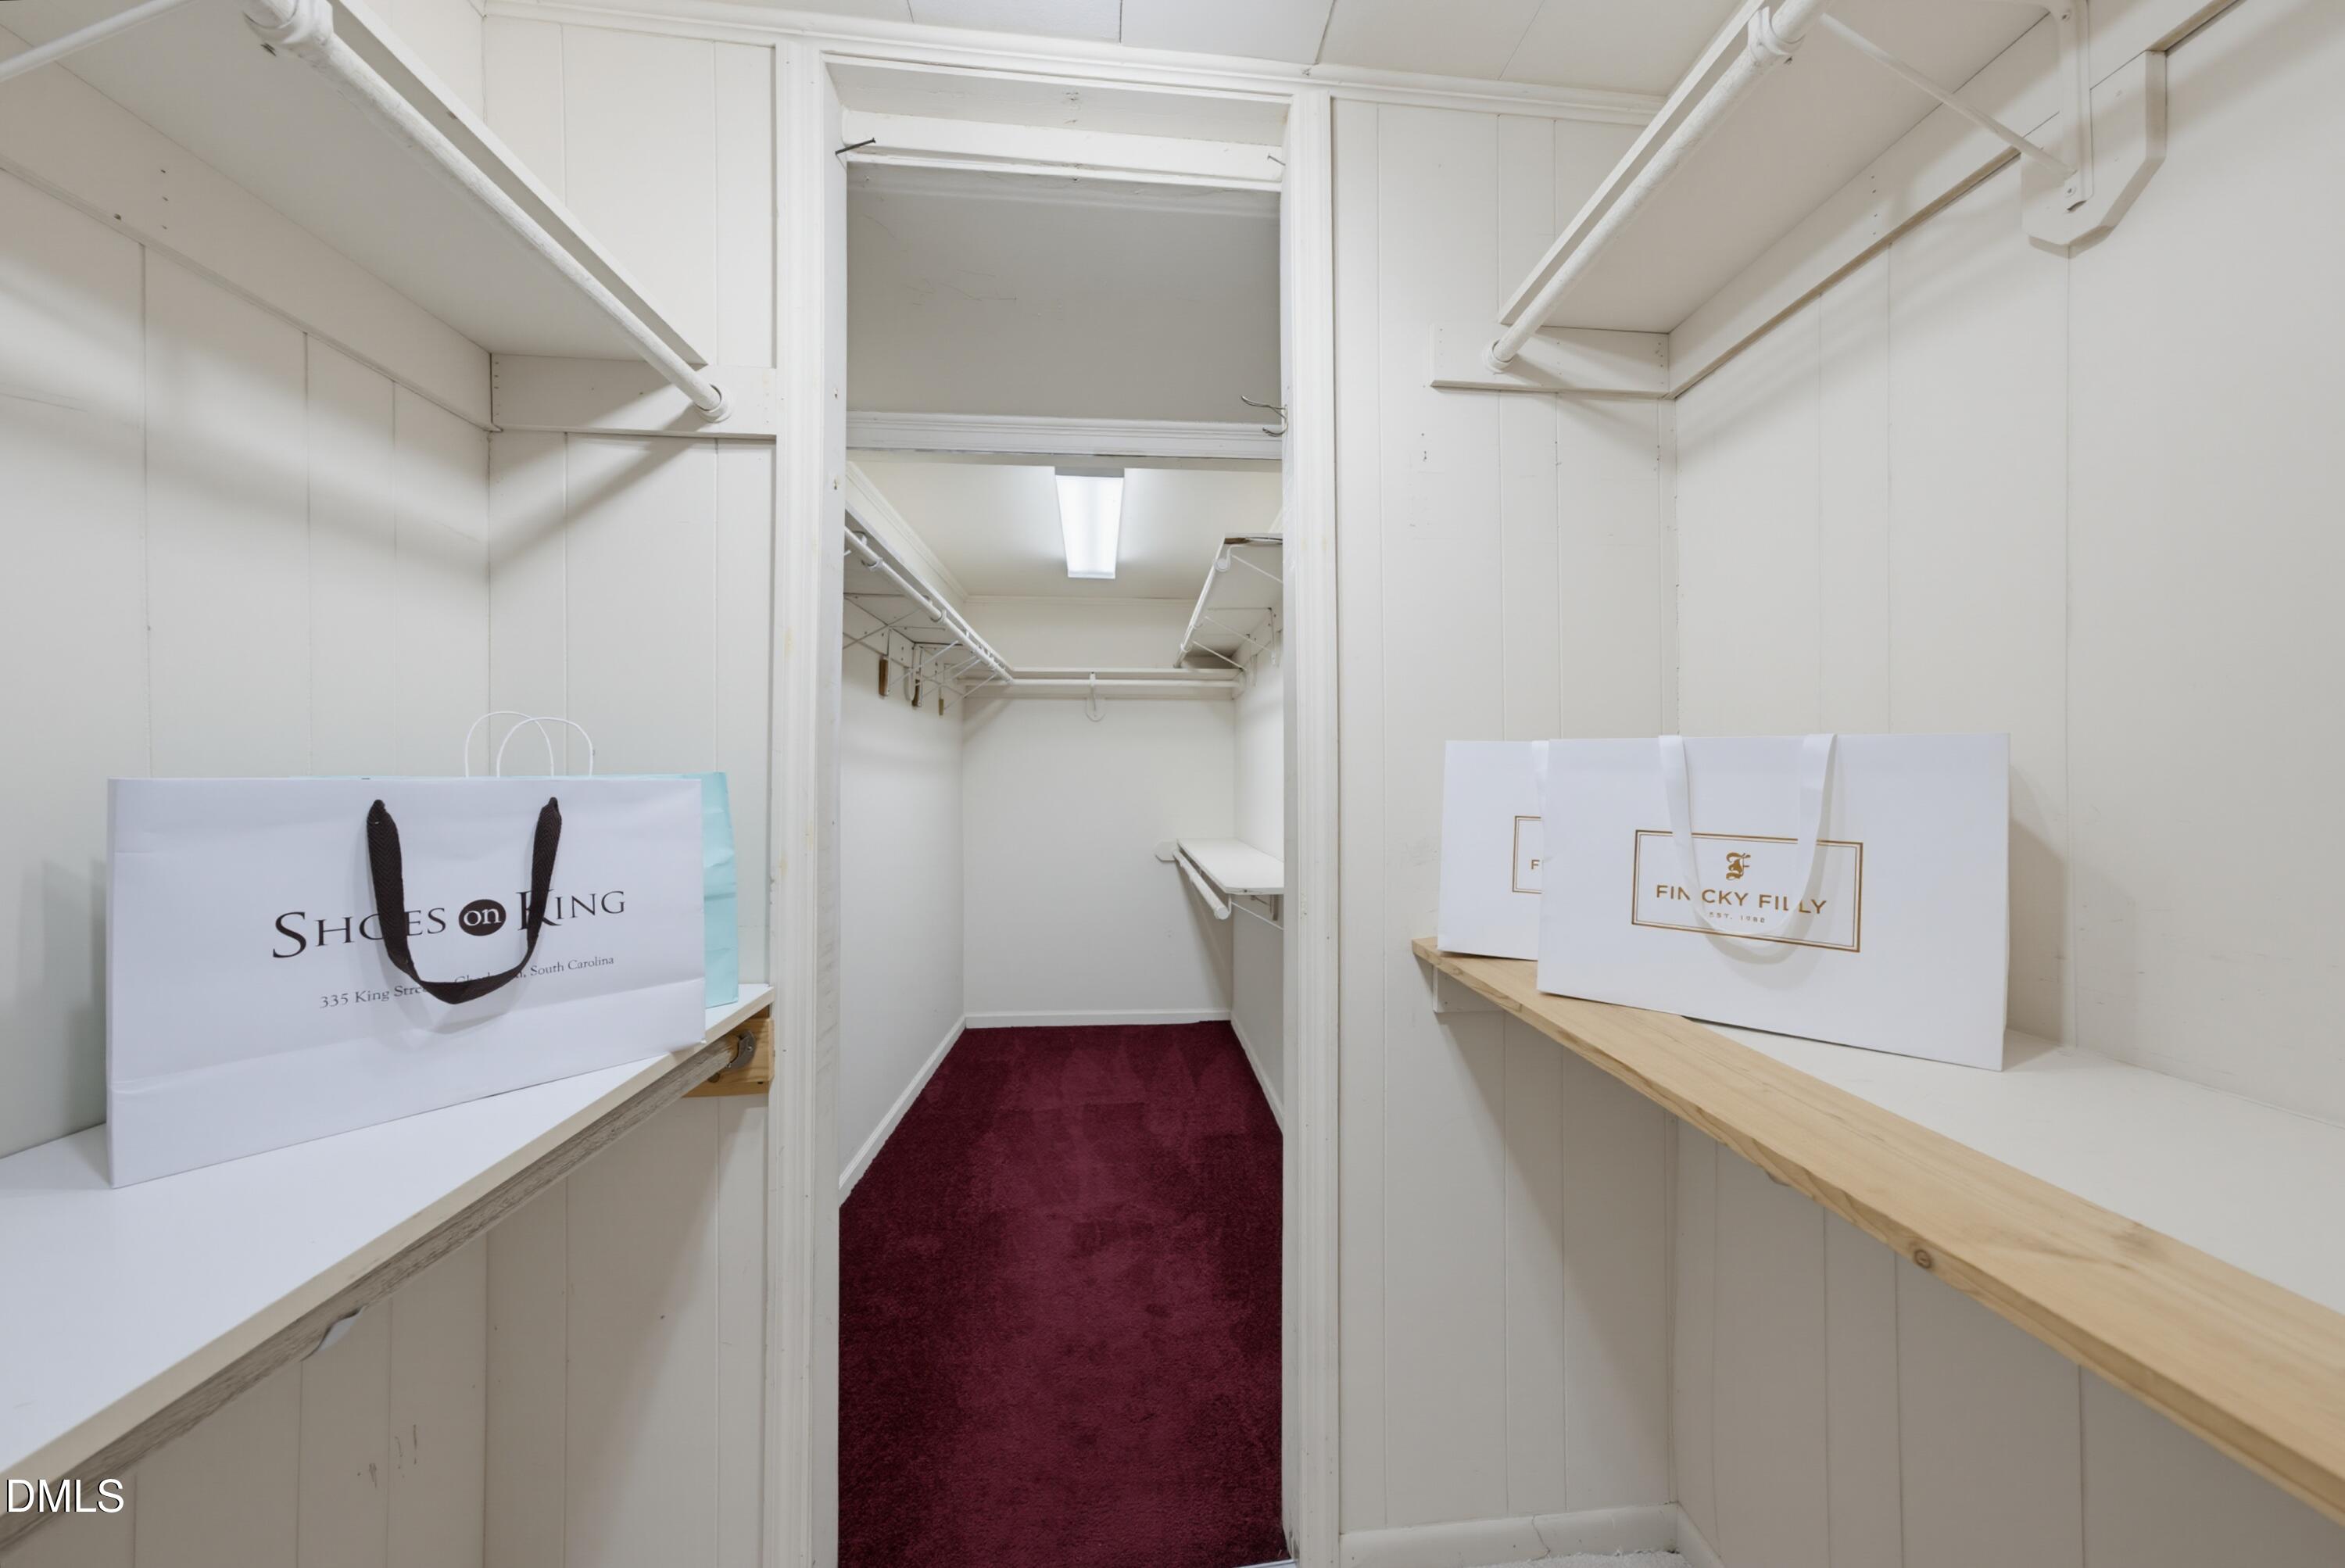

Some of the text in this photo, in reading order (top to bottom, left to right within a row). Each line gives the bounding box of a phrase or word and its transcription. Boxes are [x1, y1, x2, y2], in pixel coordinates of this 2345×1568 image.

[1656, 884, 1749, 908] FINCKY
[464, 908, 502, 927] on
[320, 993, 349, 1008] 335
[355, 990, 390, 1003] King
[531, 961, 564, 976] South
[567, 956, 614, 970] Carolina
